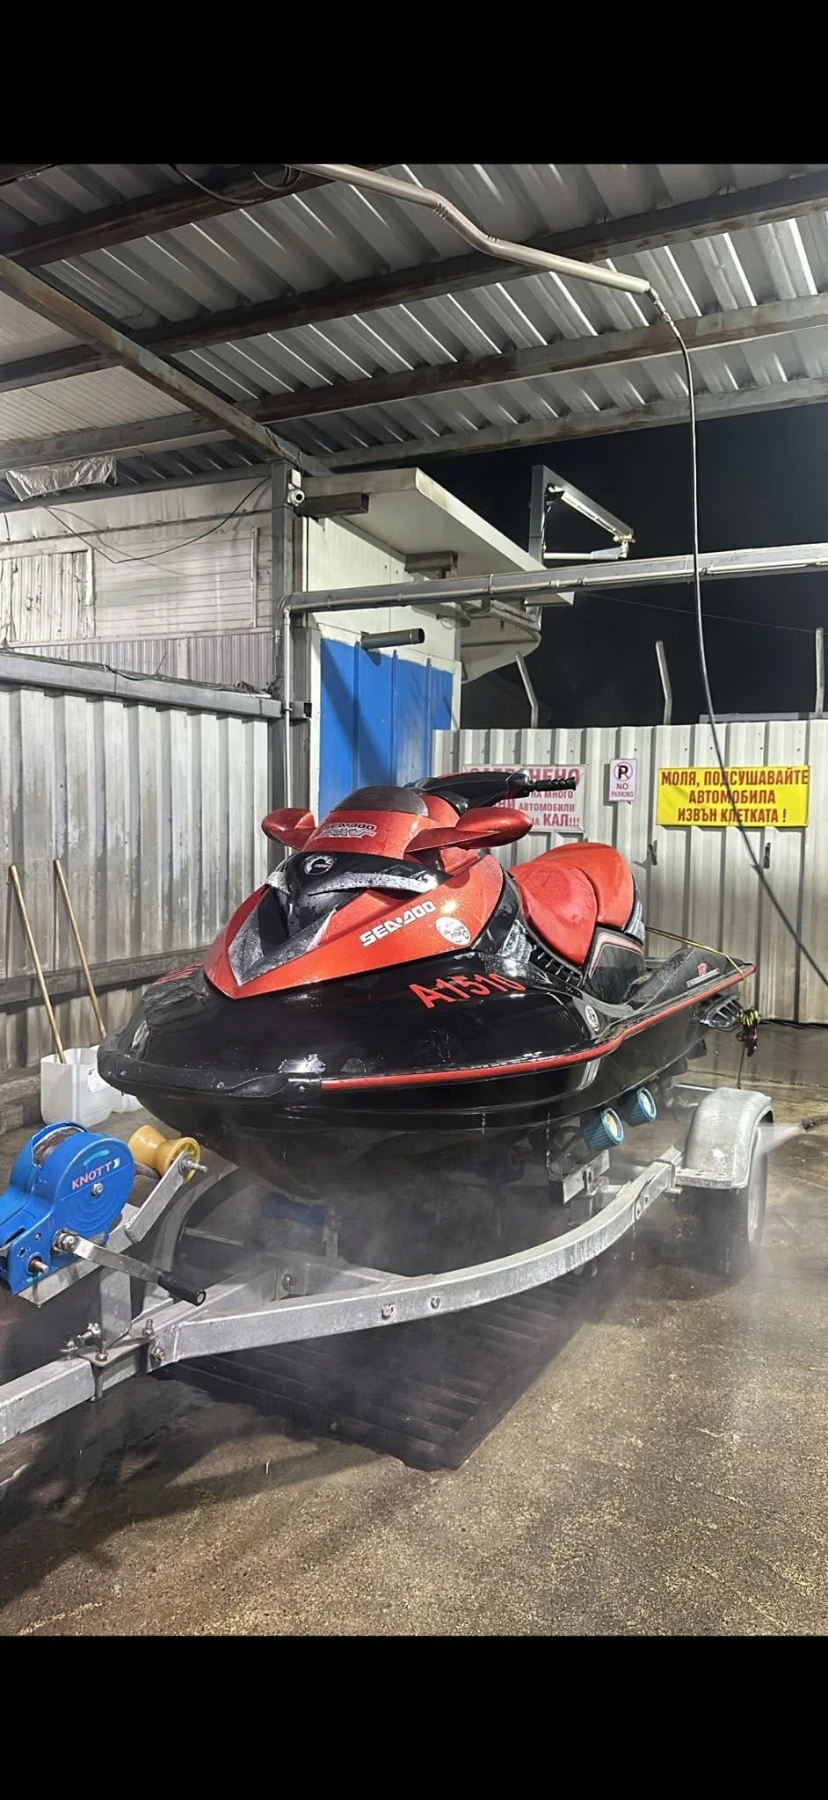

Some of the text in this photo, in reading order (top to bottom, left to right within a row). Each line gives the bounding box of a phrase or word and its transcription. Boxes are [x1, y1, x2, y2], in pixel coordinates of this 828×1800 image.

[661, 767, 809, 787] МОЛЯ, ПОДСУШАВАЙТЕ
[688, 790, 776, 804] АВТОМОБИЛА
[519, 803, 575, 812] АВТОМОБИЛИ
[677, 808, 717, 822] ИЗВЪН
[720, 808, 779, 823] КЛЕТКАТА
[72, 1161, 113, 1190] KNOTT
